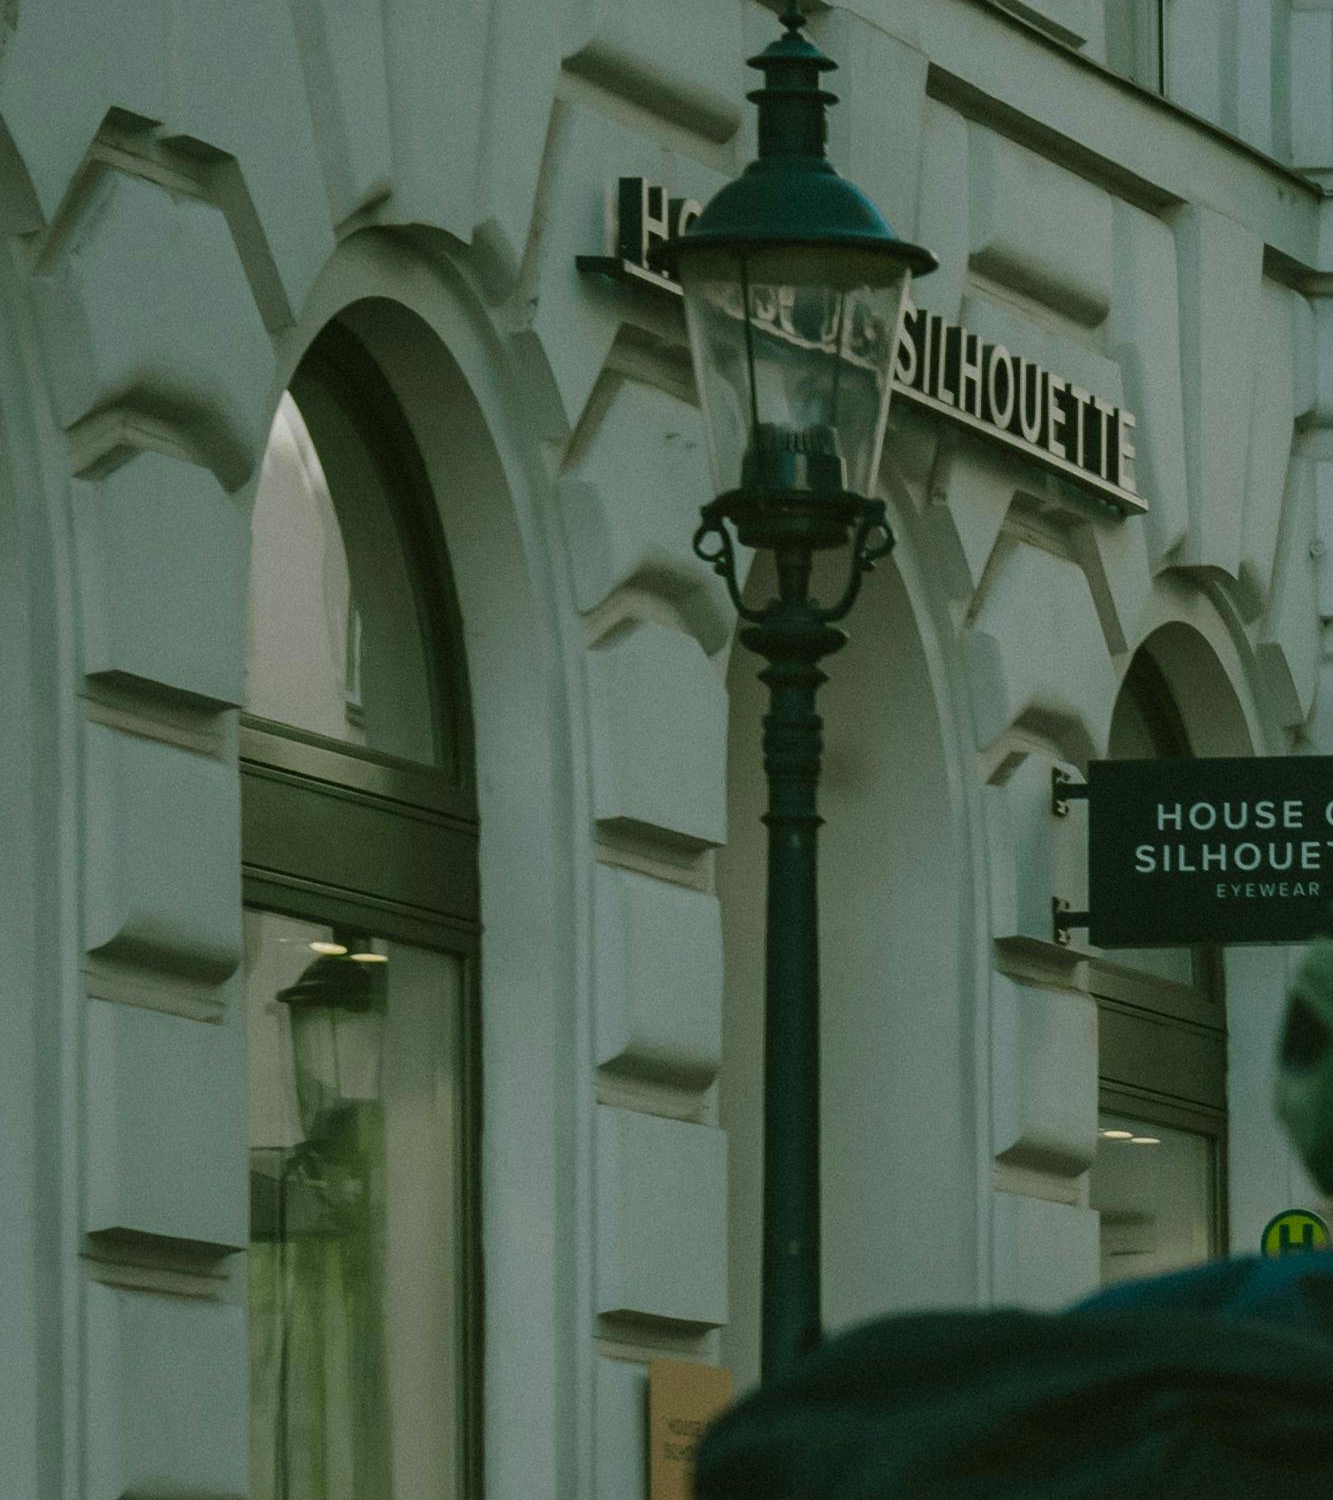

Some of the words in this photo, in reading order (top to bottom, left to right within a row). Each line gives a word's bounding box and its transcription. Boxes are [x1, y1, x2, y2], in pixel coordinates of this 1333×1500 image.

[894, 305, 1137, 493] SILHOUETTE
[1156, 801, 1304, 831] HOUSE
[1216, 882, 1321, 899] EYEWEAR
